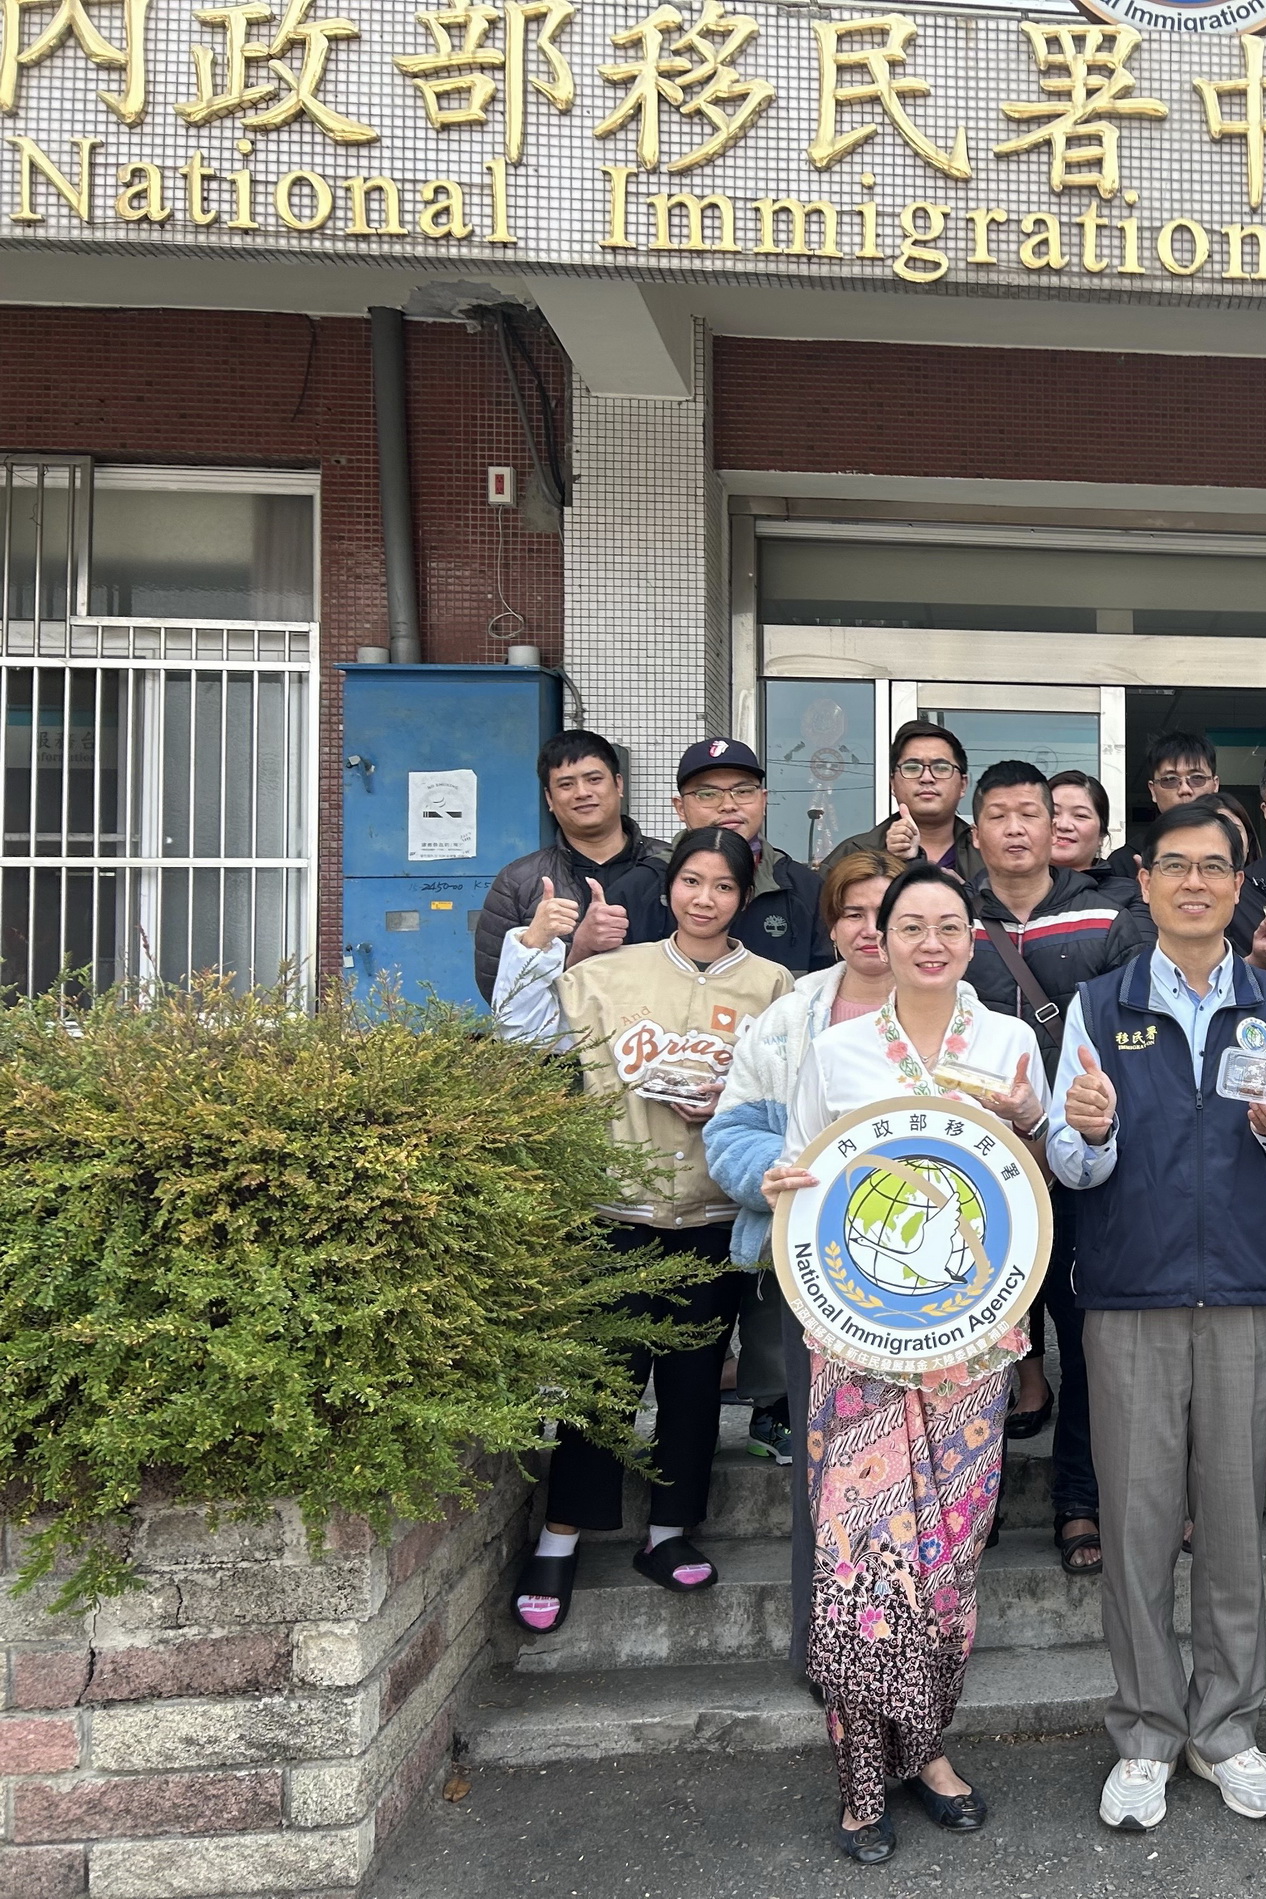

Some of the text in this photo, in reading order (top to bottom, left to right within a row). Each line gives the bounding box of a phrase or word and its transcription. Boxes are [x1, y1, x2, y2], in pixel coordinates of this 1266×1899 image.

[7, 134, 518, 245] National
[621, 1006, 652, 1027] And
[1115, 1025, 1157, 1045] 移民署
[837, 1114, 1021, 1182] 內政部移民署
[794, 1241, 1026, 1356] National Immigration Agency
